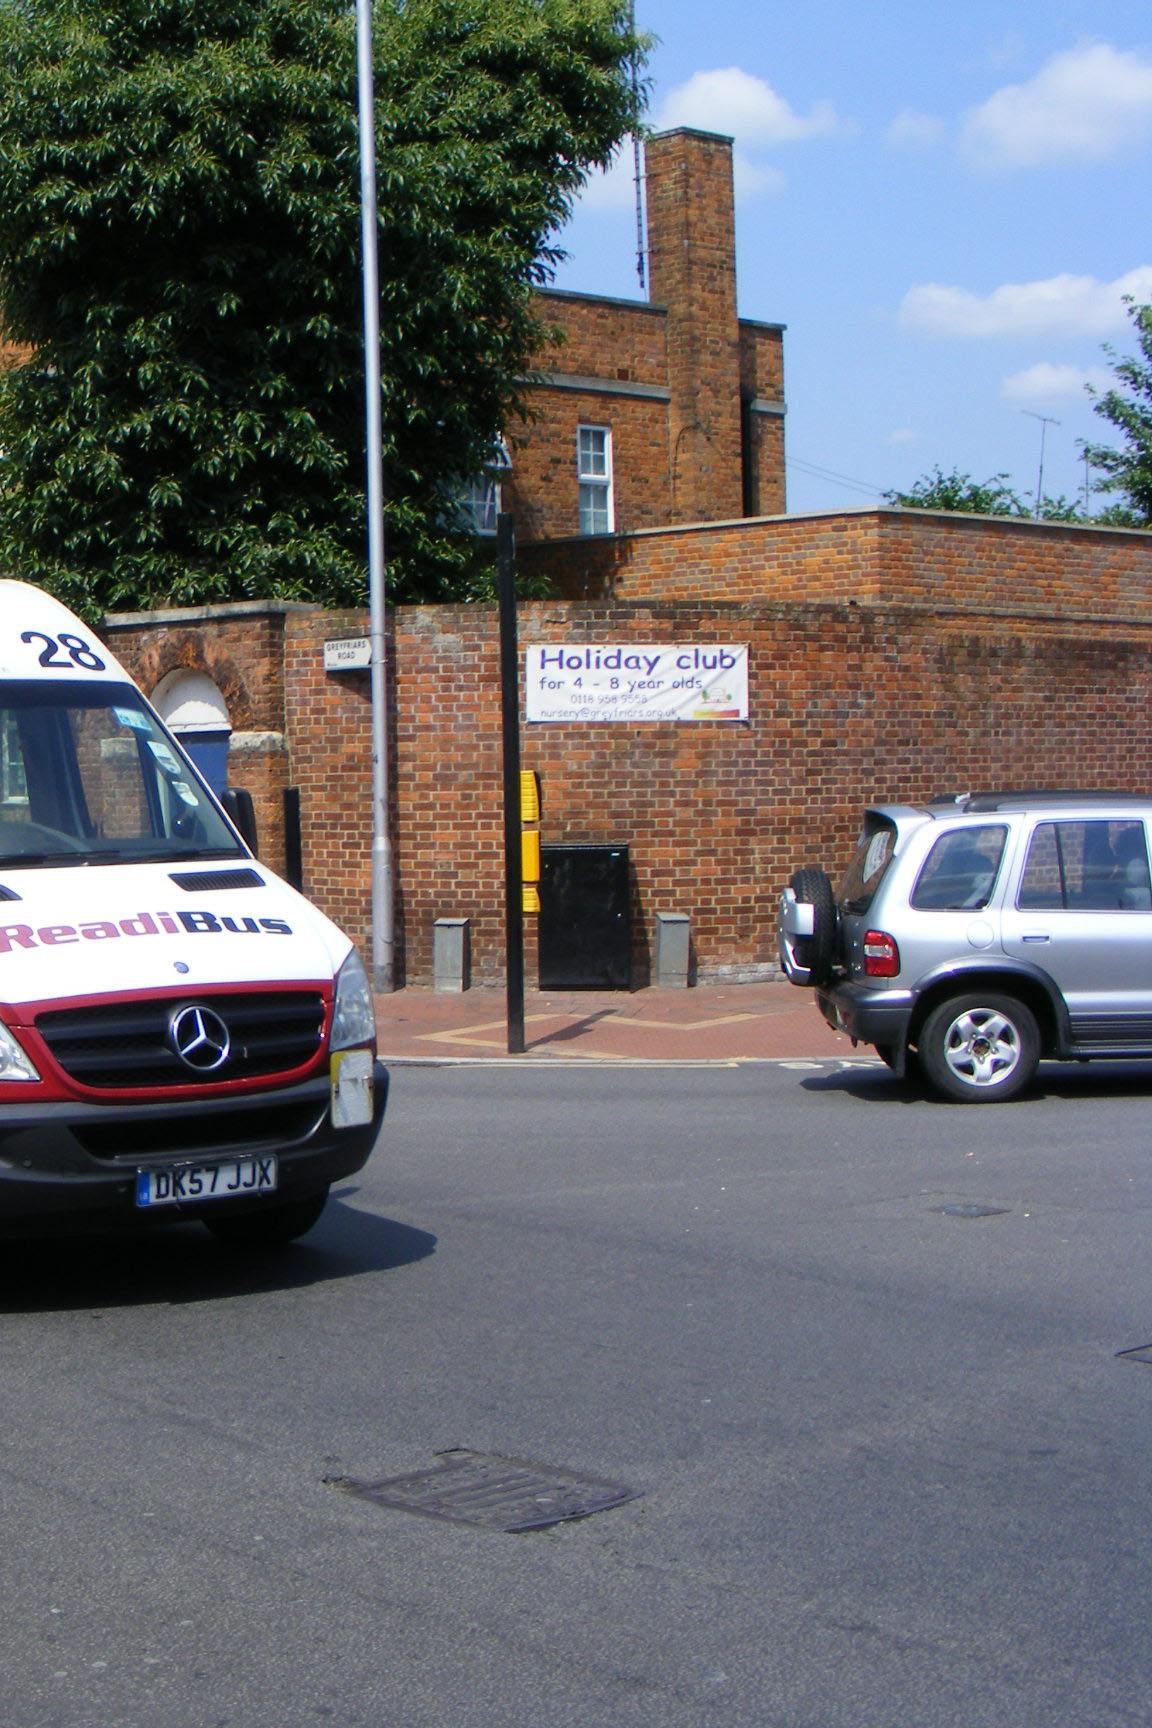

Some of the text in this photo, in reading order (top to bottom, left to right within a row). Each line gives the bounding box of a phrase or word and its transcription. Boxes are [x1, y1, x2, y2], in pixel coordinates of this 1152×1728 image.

[20, 631, 106, 671] 28
[327, 640, 366, 651] GREYFRIARS
[338, 651, 355, 660] ROAD
[540, 648, 736, 676] Holiday club
[539, 677, 564, 690] for
[573, 677, 583, 689] 4
[610, 677, 620, 689] 8
[627, 679, 664, 693] year
[672, 676, 703, 690] olds
[570, 694, 594, 704] 0118
[155, 1159, 272, 1200] DK57 JJX
